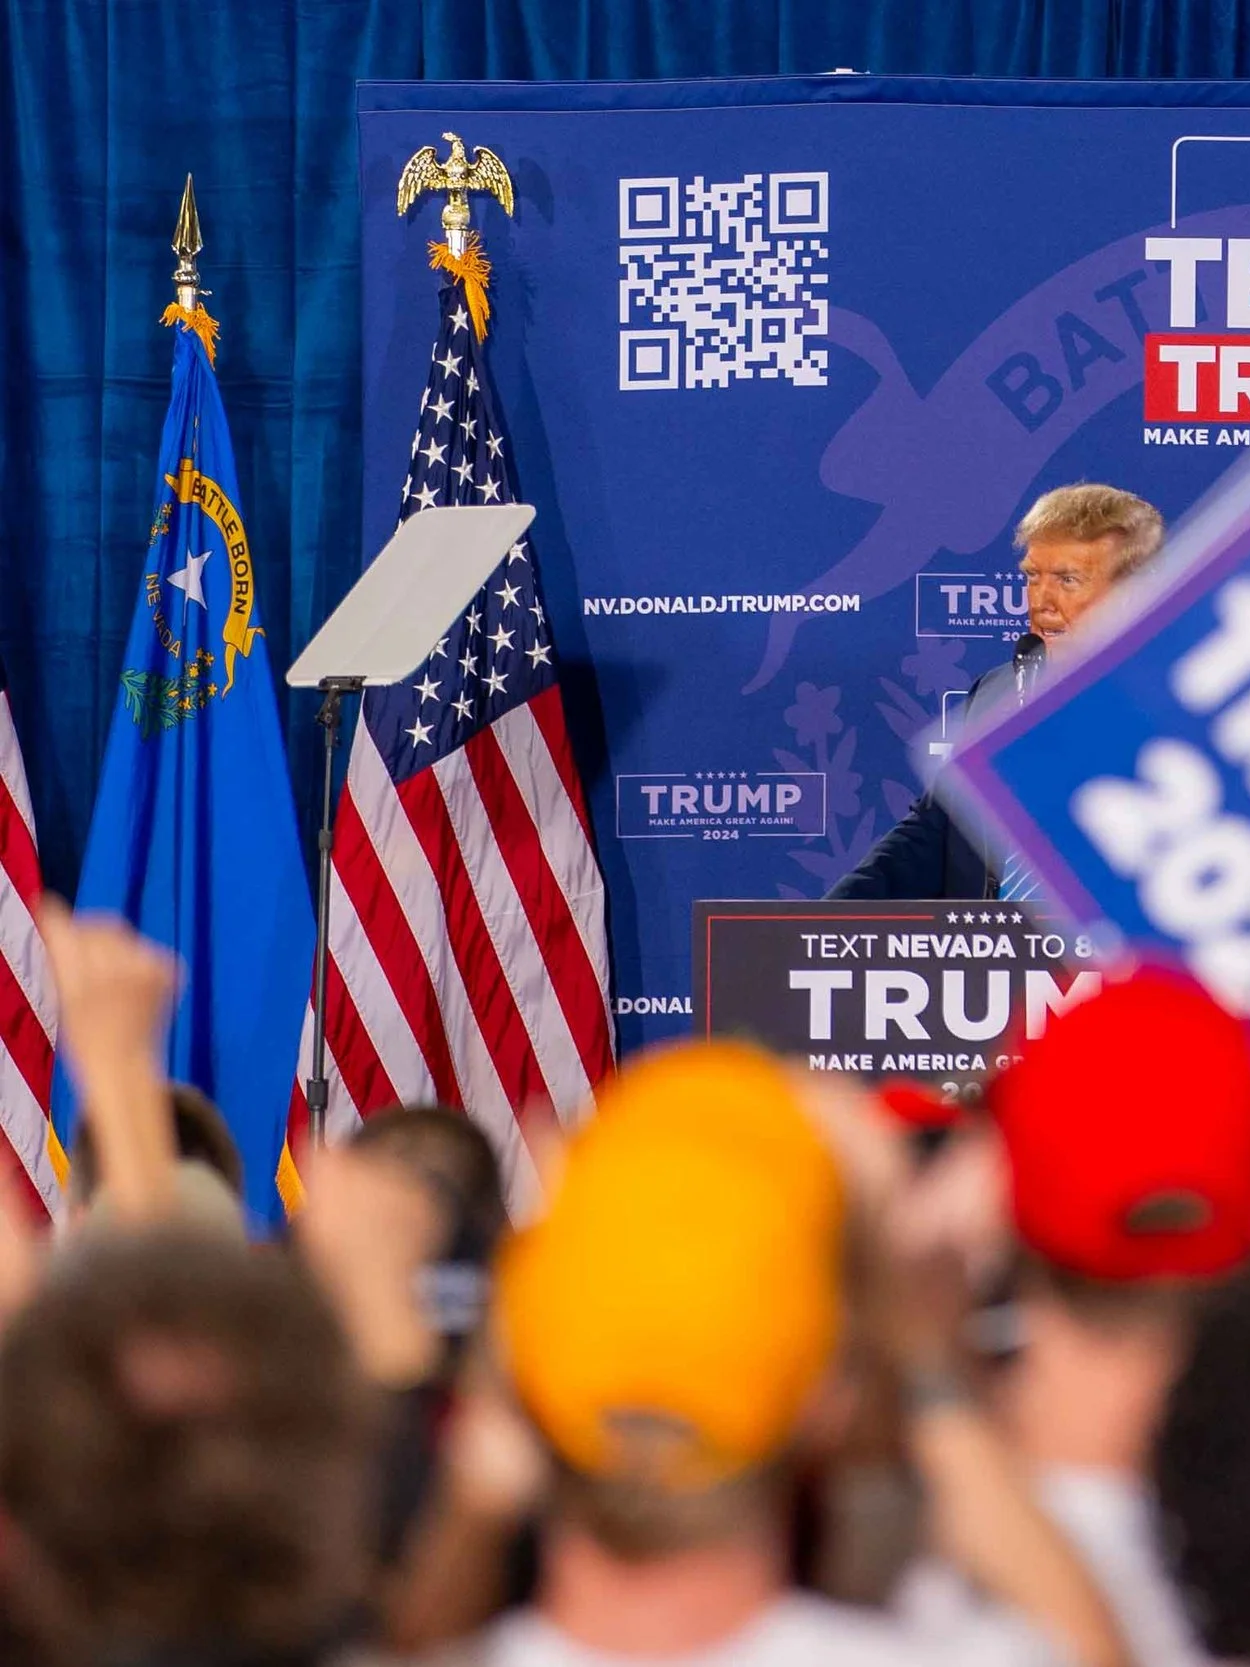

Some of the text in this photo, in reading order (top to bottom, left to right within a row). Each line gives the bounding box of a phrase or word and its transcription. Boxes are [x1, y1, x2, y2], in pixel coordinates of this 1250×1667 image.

[1143, 428, 1209, 446] MAKE
[192, 476, 250, 615] BATTLE BORN
[584, 594, 860, 616] NV.DONALDJTRUMP.COM
[940, 585, 1029, 616] TRU
[948, 618, 976, 627] MAKE
[979, 618, 1022, 627] AMERICA
[1002, 631, 1027, 642] 20
[640, 784, 802, 815] TRUMP
[648, 816, 794, 827] MAKE AMERICA GREAT AGAIN!
[702, 829, 740, 841] 2024
[801, 934, 878, 959] TEXT
[887, 934, 1017, 959] NEVADA
[1024, 934, 1065, 959] TO
[789, 969, 1103, 1041] TRUM
[809, 1053, 874, 1072] MAKE
[881, 1053, 987, 1072] AMERICA
